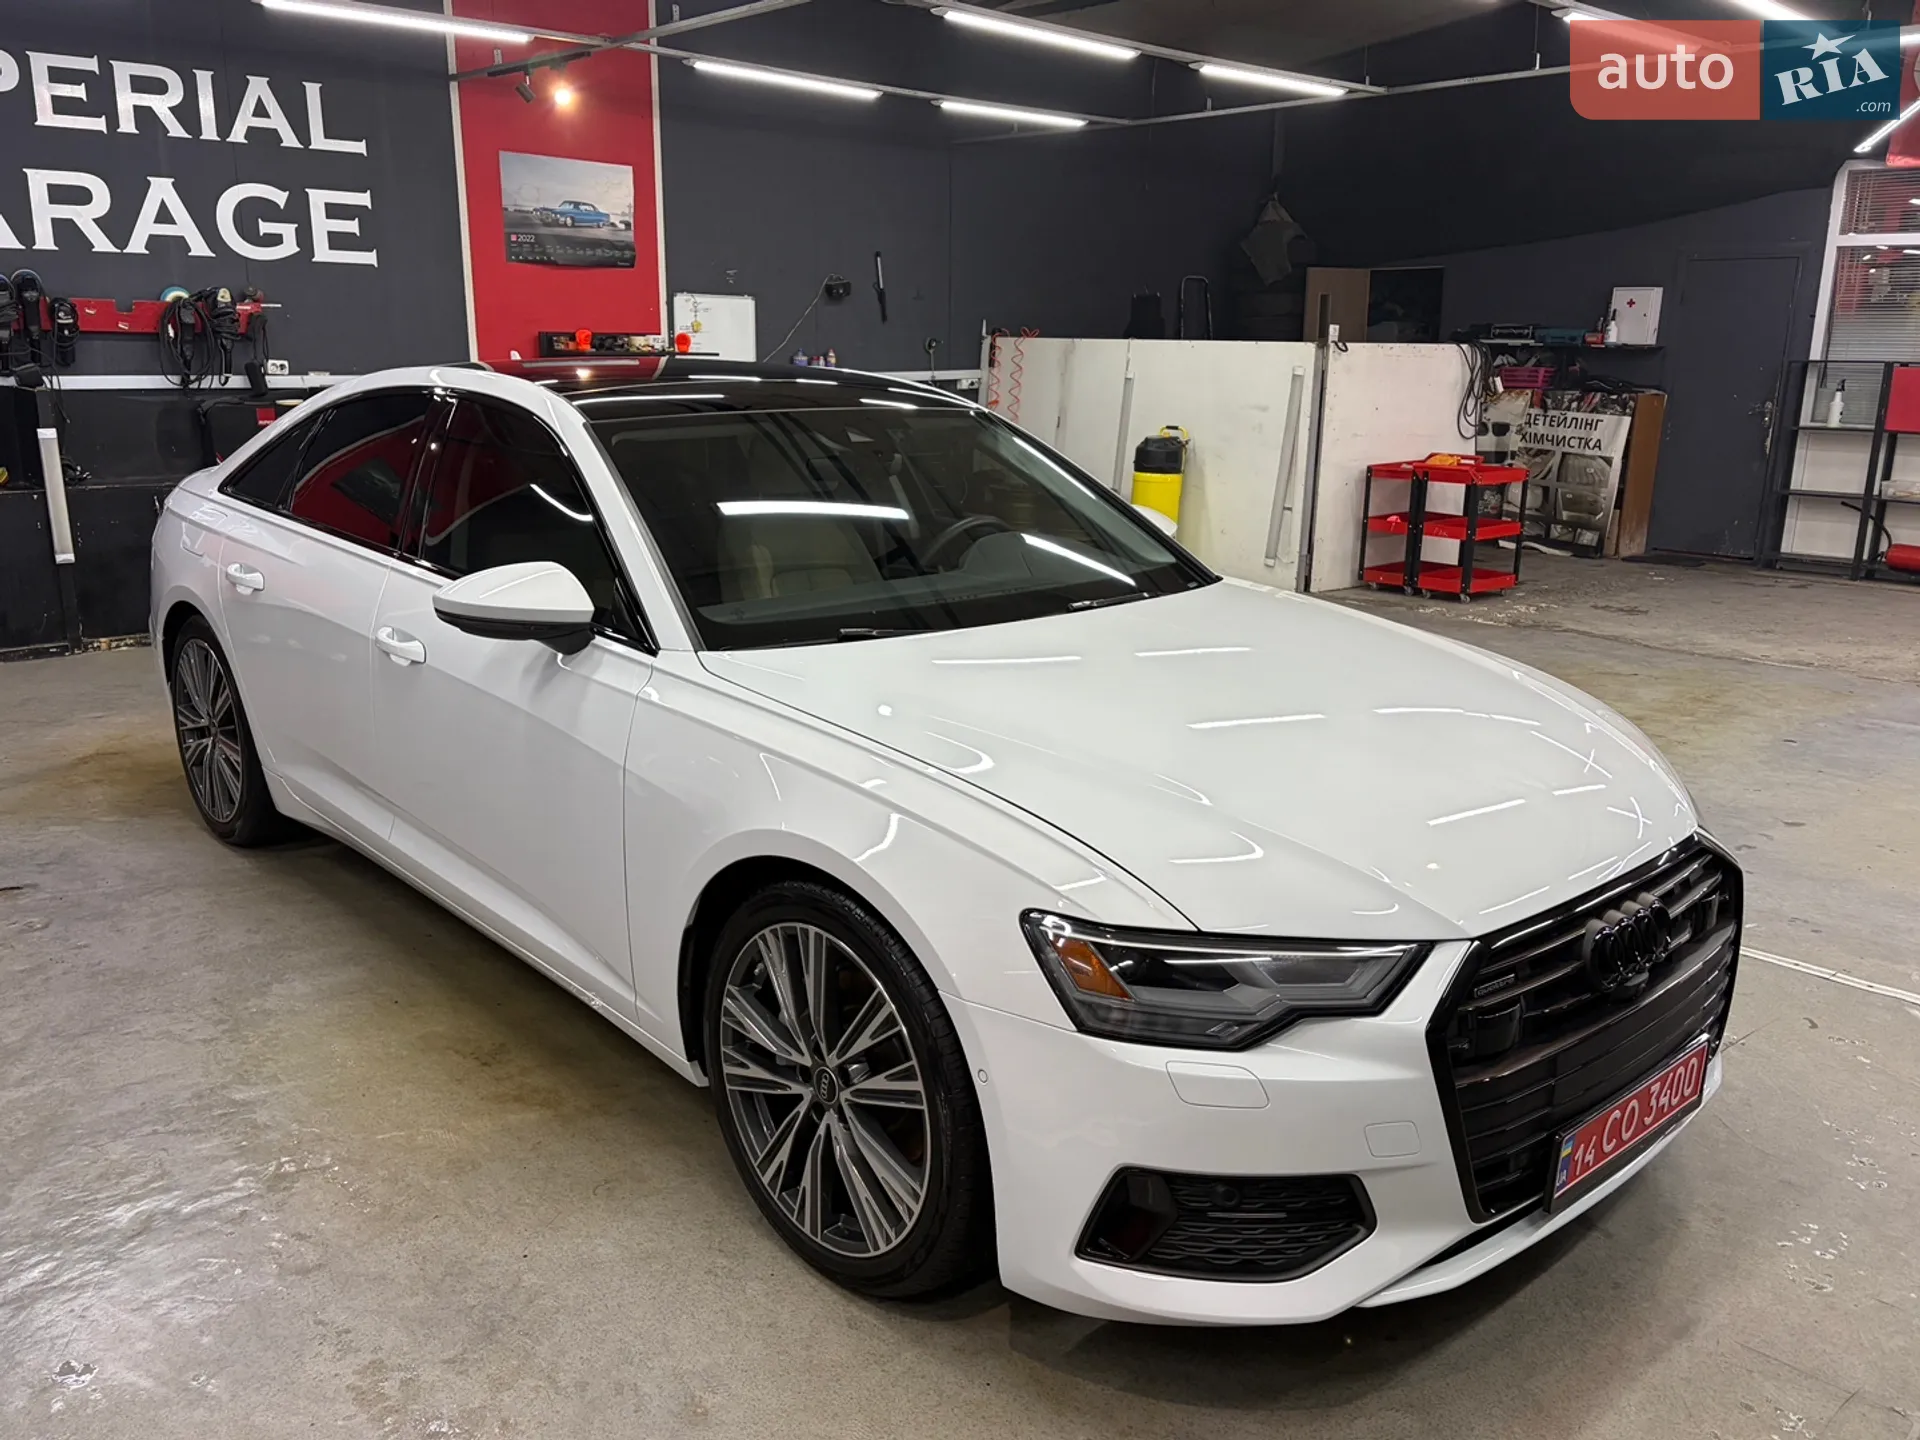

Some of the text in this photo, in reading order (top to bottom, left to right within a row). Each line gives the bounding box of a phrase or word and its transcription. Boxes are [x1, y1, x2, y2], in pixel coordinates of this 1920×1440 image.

[518, 233, 536, 243] 2022
[1524, 412, 1604, 432] ДЕТЕЙЛІНГ
[1520, 431, 1603, 451] ХІМЧИСТКА
[1575, 1057, 1698, 1176] 14 CO 3400
